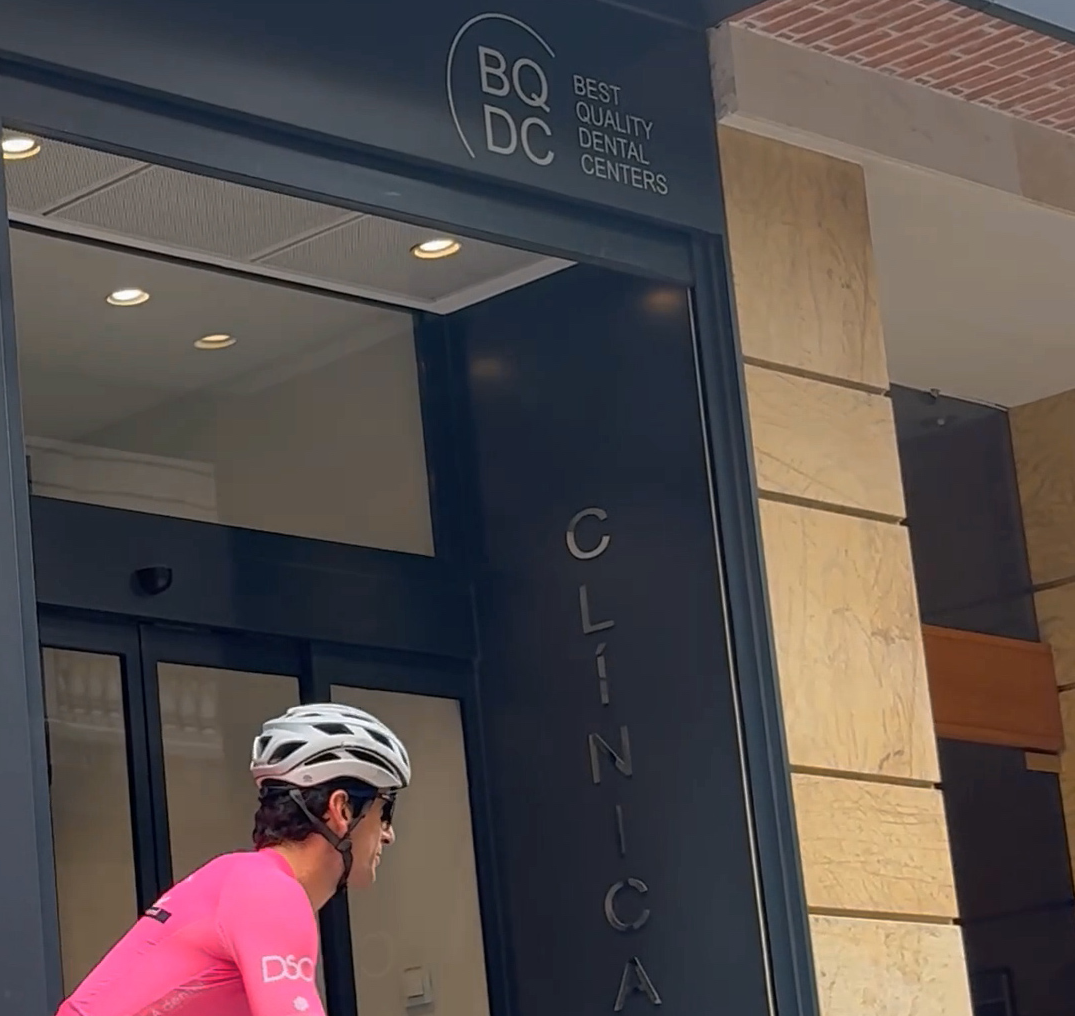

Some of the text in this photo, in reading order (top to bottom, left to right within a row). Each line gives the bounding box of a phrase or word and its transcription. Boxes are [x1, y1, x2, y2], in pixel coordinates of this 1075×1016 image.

[478, 45, 551, 113] BQ
[573, 74, 621, 105] BEST
[483, 103, 555, 166] DC
[575, 101, 653, 140] QUALITY
[578, 127, 650, 165] DENTAL
[580, 154, 668, 195] CENTERS
[566, 507, 661, 1012] CLÍNICA
[261, 954, 315, 983] DSC
